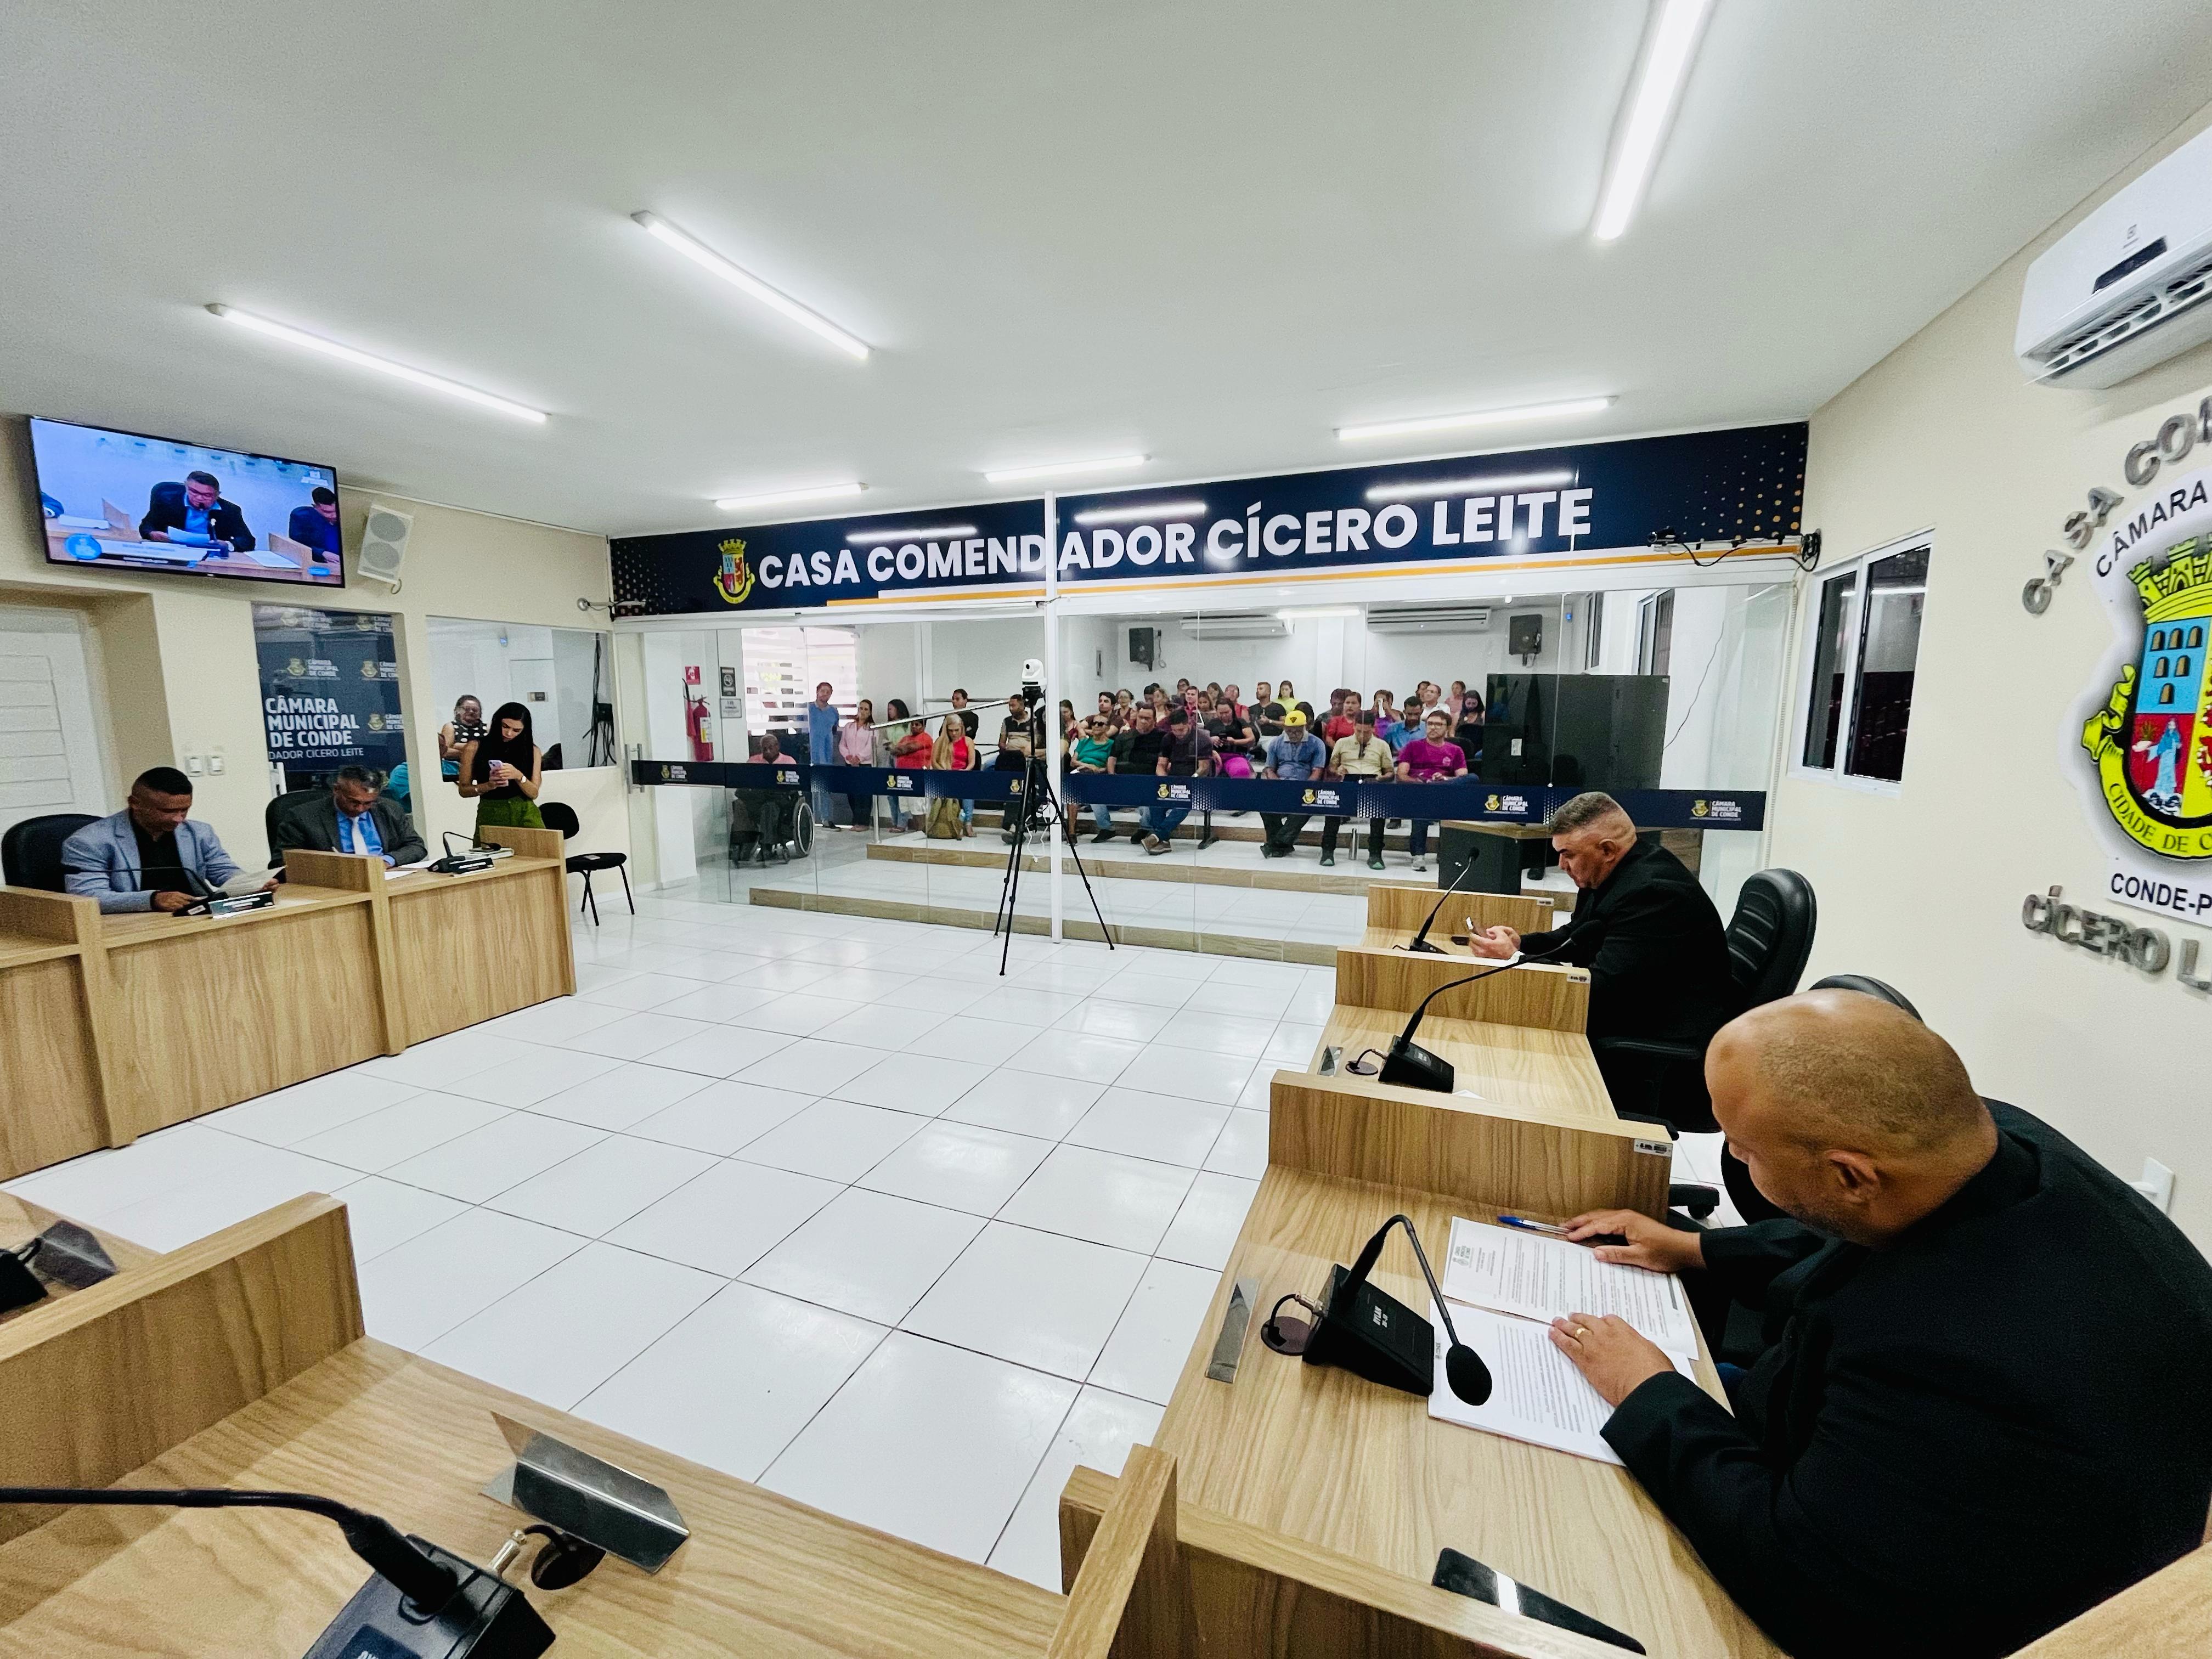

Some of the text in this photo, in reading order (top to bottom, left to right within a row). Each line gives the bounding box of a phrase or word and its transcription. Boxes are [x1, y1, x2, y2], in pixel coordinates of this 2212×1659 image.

[759, 487, 1593, 589] CASA COMENDADOR CÍCERO LEITE
[2022, 486, 2124, 616] CASA
[2096, 479, 2208, 578] CÂMARA
[265, 695, 339, 714] CÂMARA
[267, 714, 360, 731] MUNICIPAL
[270, 730, 353, 748] DE CONDE
[341, 747, 364, 757] LEITE
[2109, 782, 2157, 842] CIDADE
[2163, 833, 2190, 853] DE
[2022, 884, 2171, 974] CÍCERO
